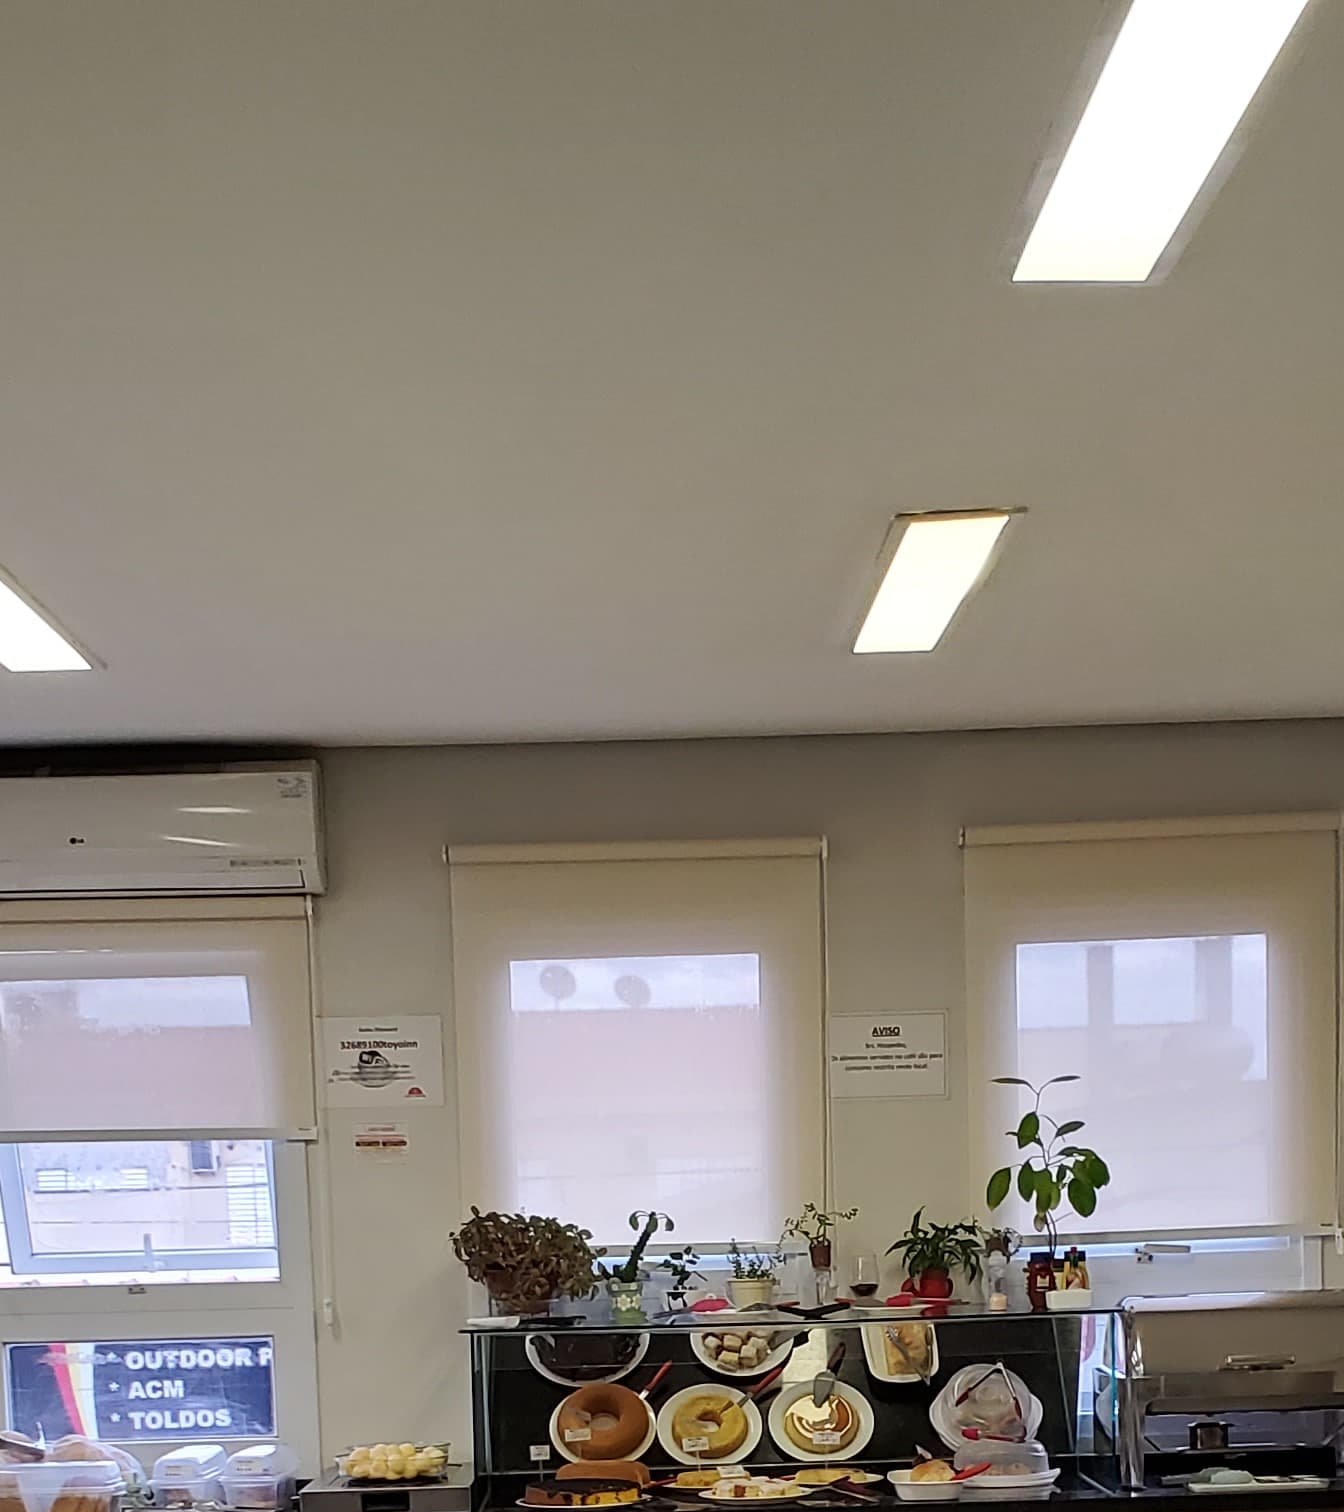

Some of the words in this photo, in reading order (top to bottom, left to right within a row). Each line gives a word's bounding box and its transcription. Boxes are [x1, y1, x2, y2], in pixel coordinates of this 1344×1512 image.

[871, 1026, 901, 1036] AVISO
[125, 1348, 254, 1370] OUTDOOR
[128, 1380, 185, 1399] ACM
[128, 1408, 233, 1430] TOLDOS
